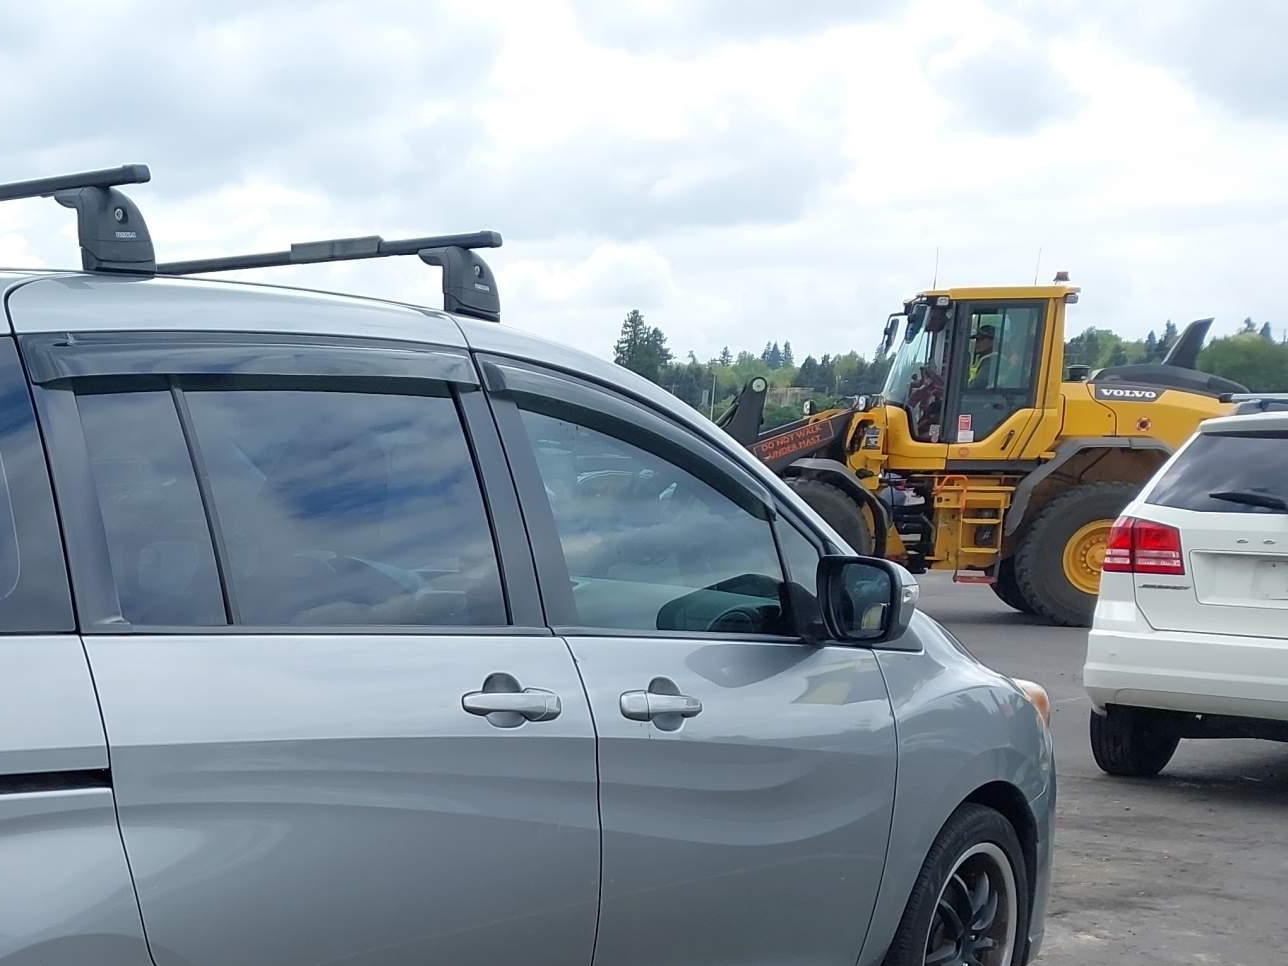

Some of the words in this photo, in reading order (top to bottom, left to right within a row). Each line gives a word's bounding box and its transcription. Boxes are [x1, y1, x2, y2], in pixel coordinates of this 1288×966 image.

[1101, 388, 1157, 399] VOLVO
[761, 441, 775, 452] DO
[775, 434, 794, 448] NOT
[796, 423, 822, 438] WALK
[798, 434, 822, 448] MAST
